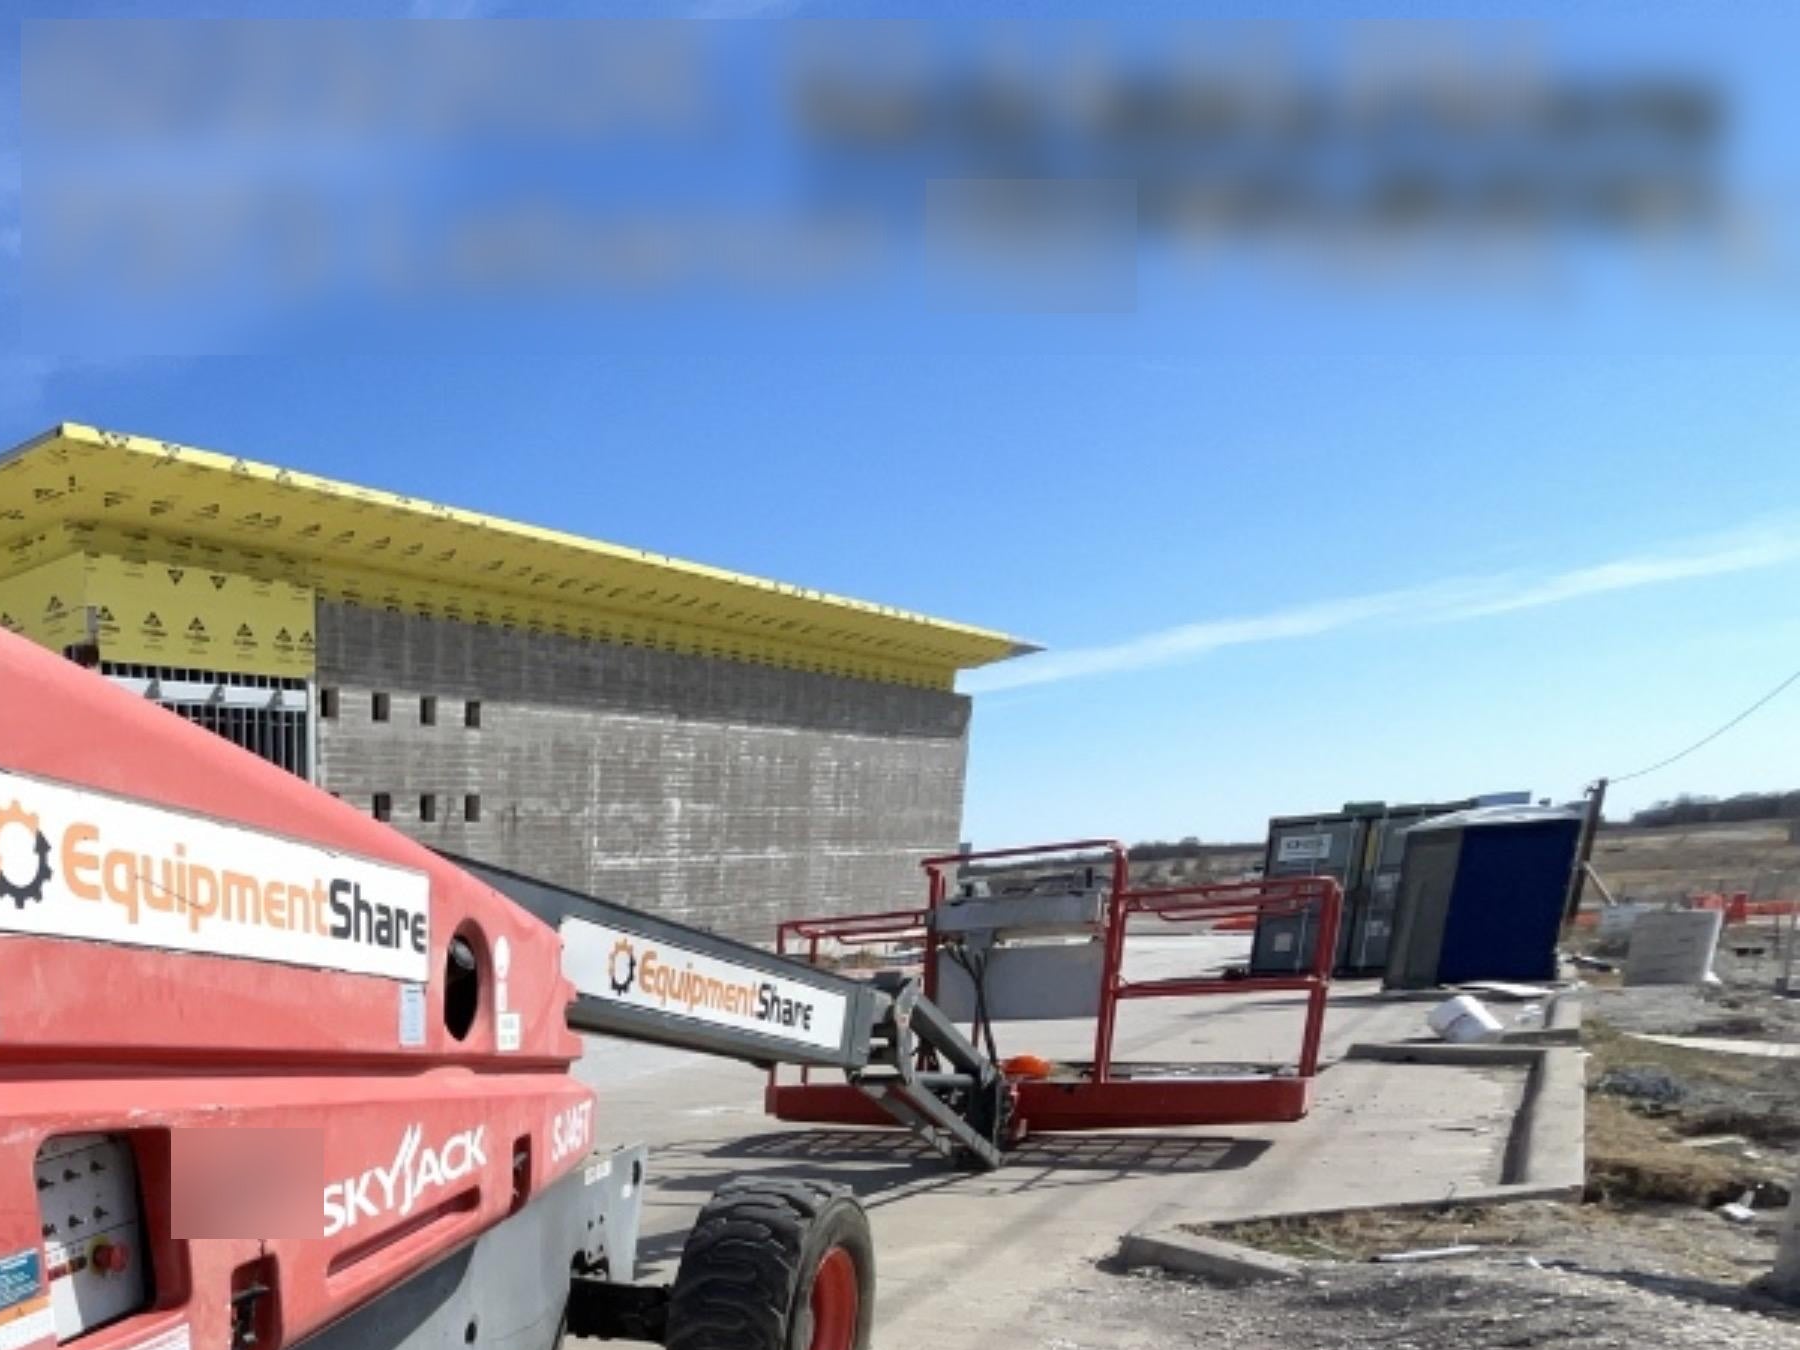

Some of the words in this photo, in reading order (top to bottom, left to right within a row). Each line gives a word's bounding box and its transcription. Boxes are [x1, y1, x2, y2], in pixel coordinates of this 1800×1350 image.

[61, 821, 427, 955] EquipmentShare
[638, 949, 814, 1031] EquipmentShare
[323, 1121, 487, 1238] SKYJACK
